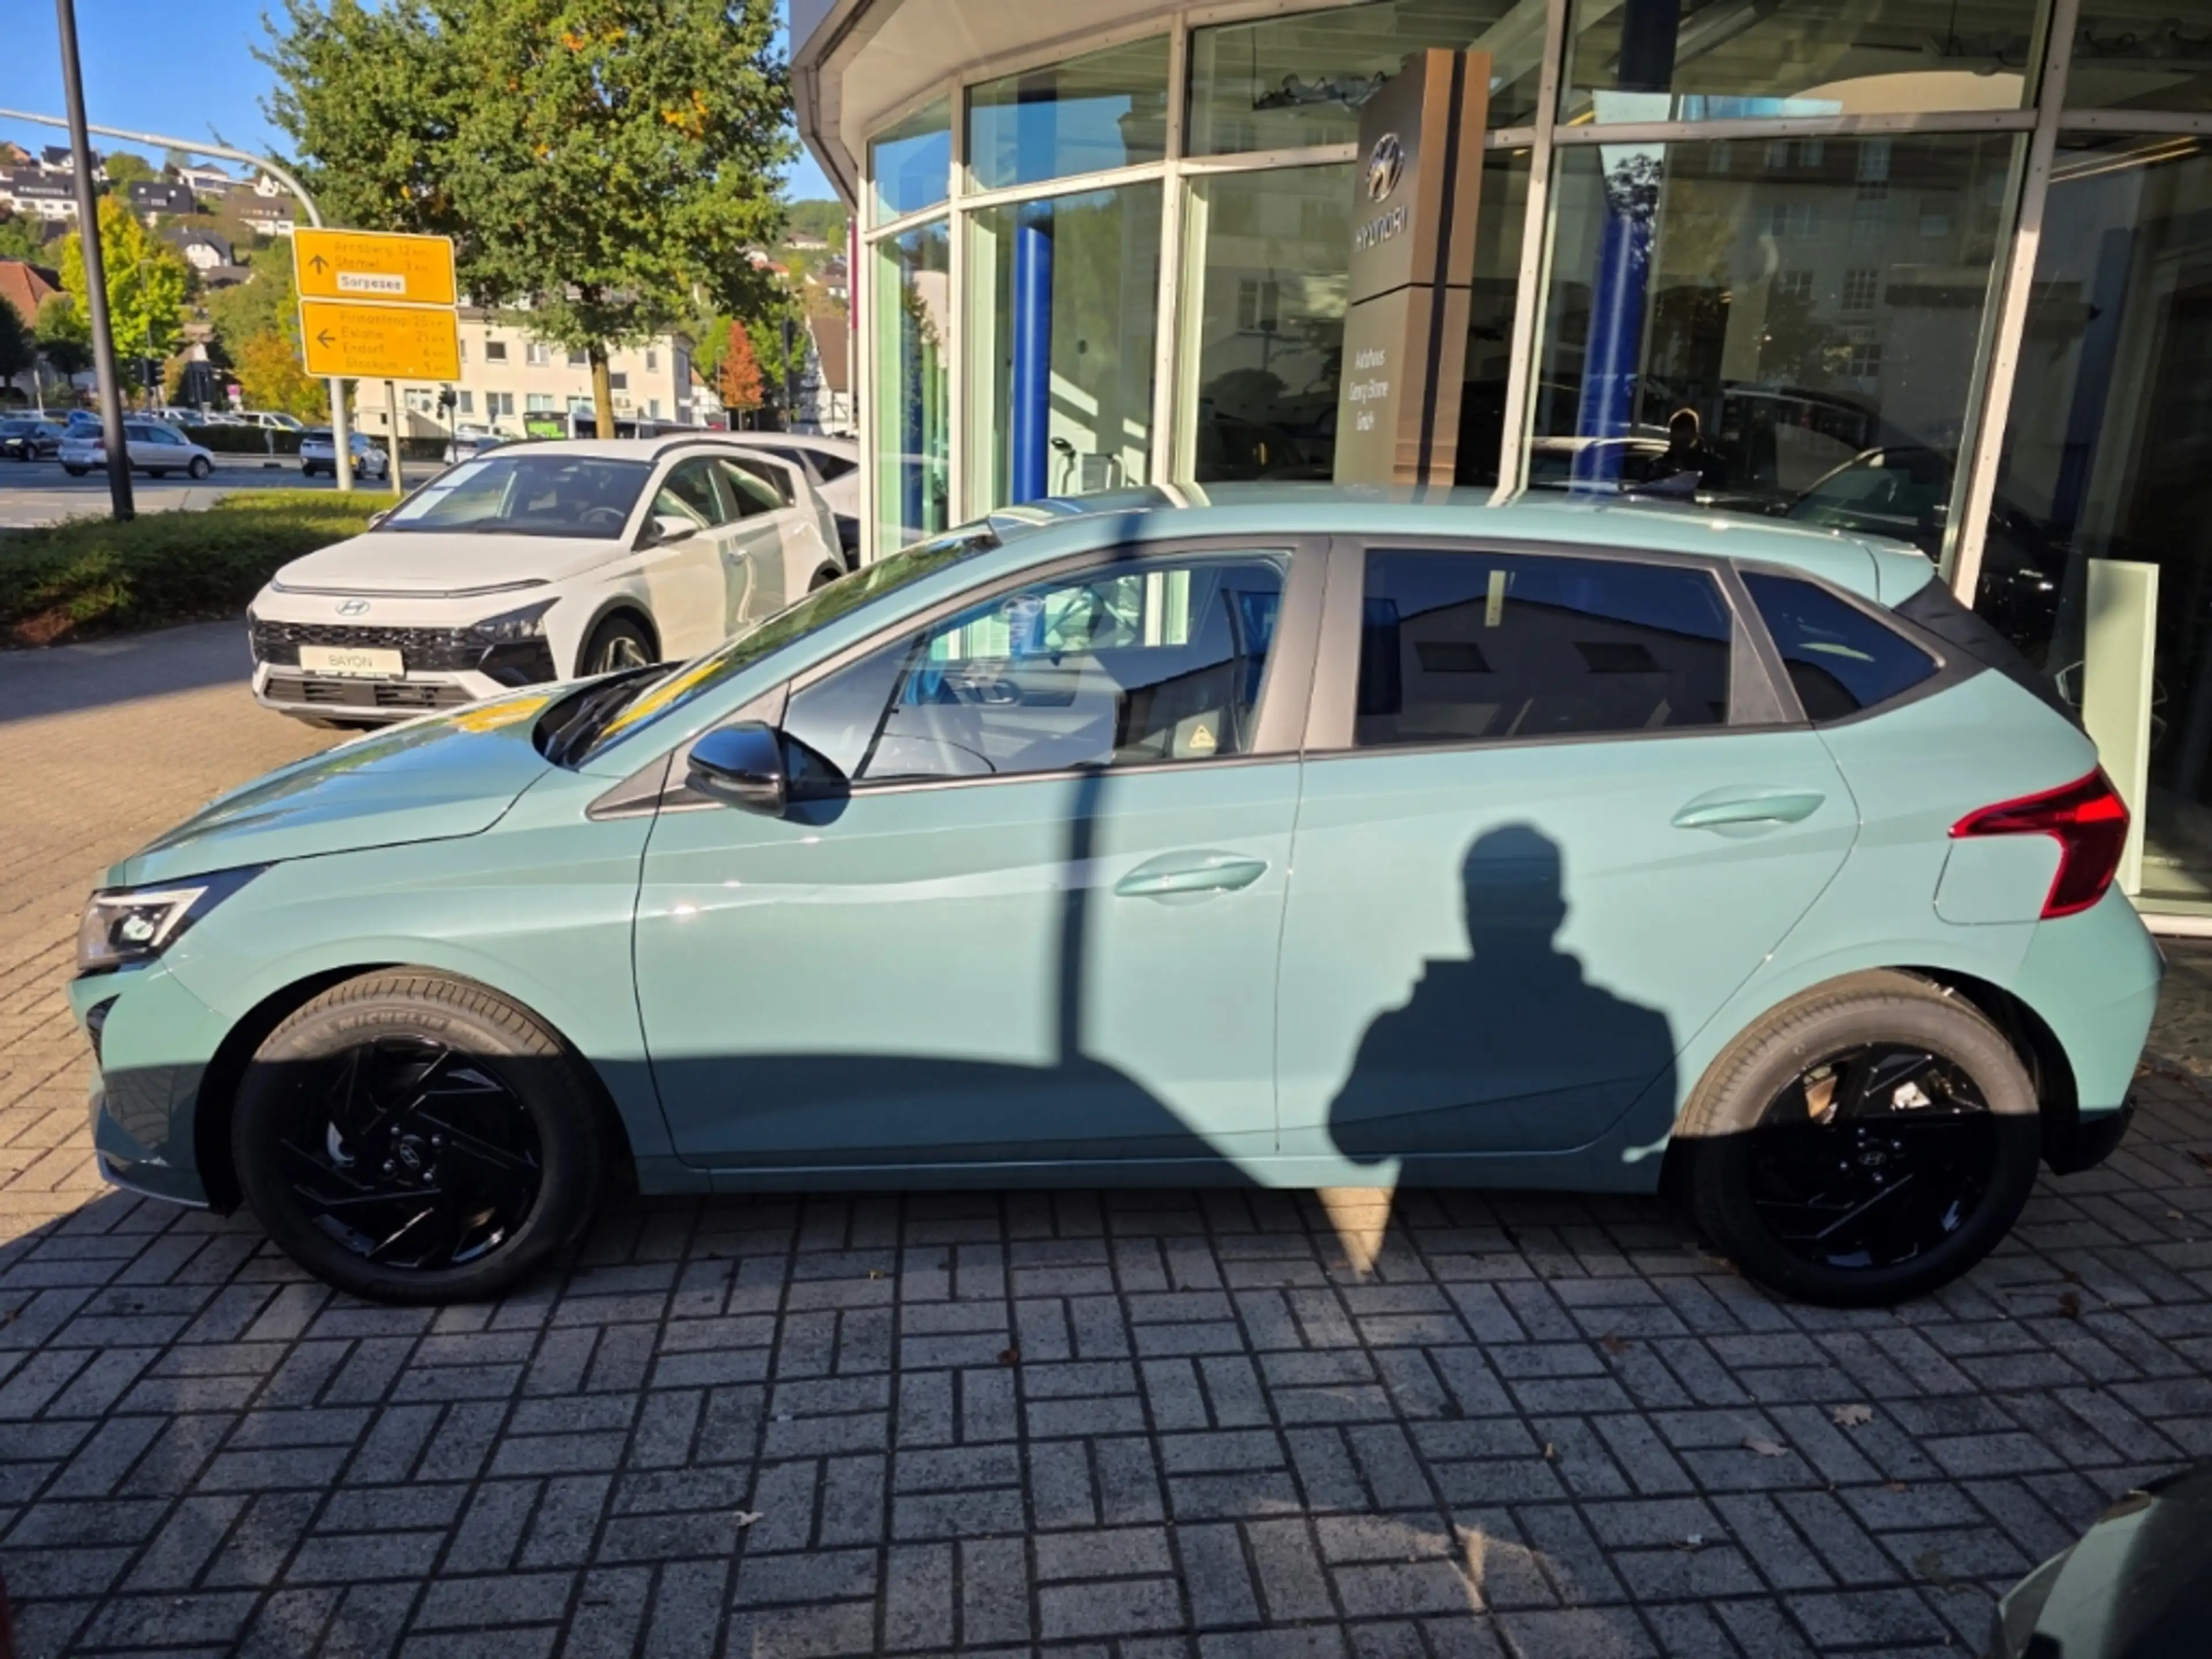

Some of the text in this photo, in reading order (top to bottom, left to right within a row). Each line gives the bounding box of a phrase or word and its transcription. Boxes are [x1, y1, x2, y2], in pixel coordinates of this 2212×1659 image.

[335, 241, 393, 258] Arnsberg
[398, 244, 410, 256] 12
[341, 275, 402, 290] Sorpesee
[328, 654, 373, 669] BAYON
[338, 1010, 449, 1031] MICHELIN
